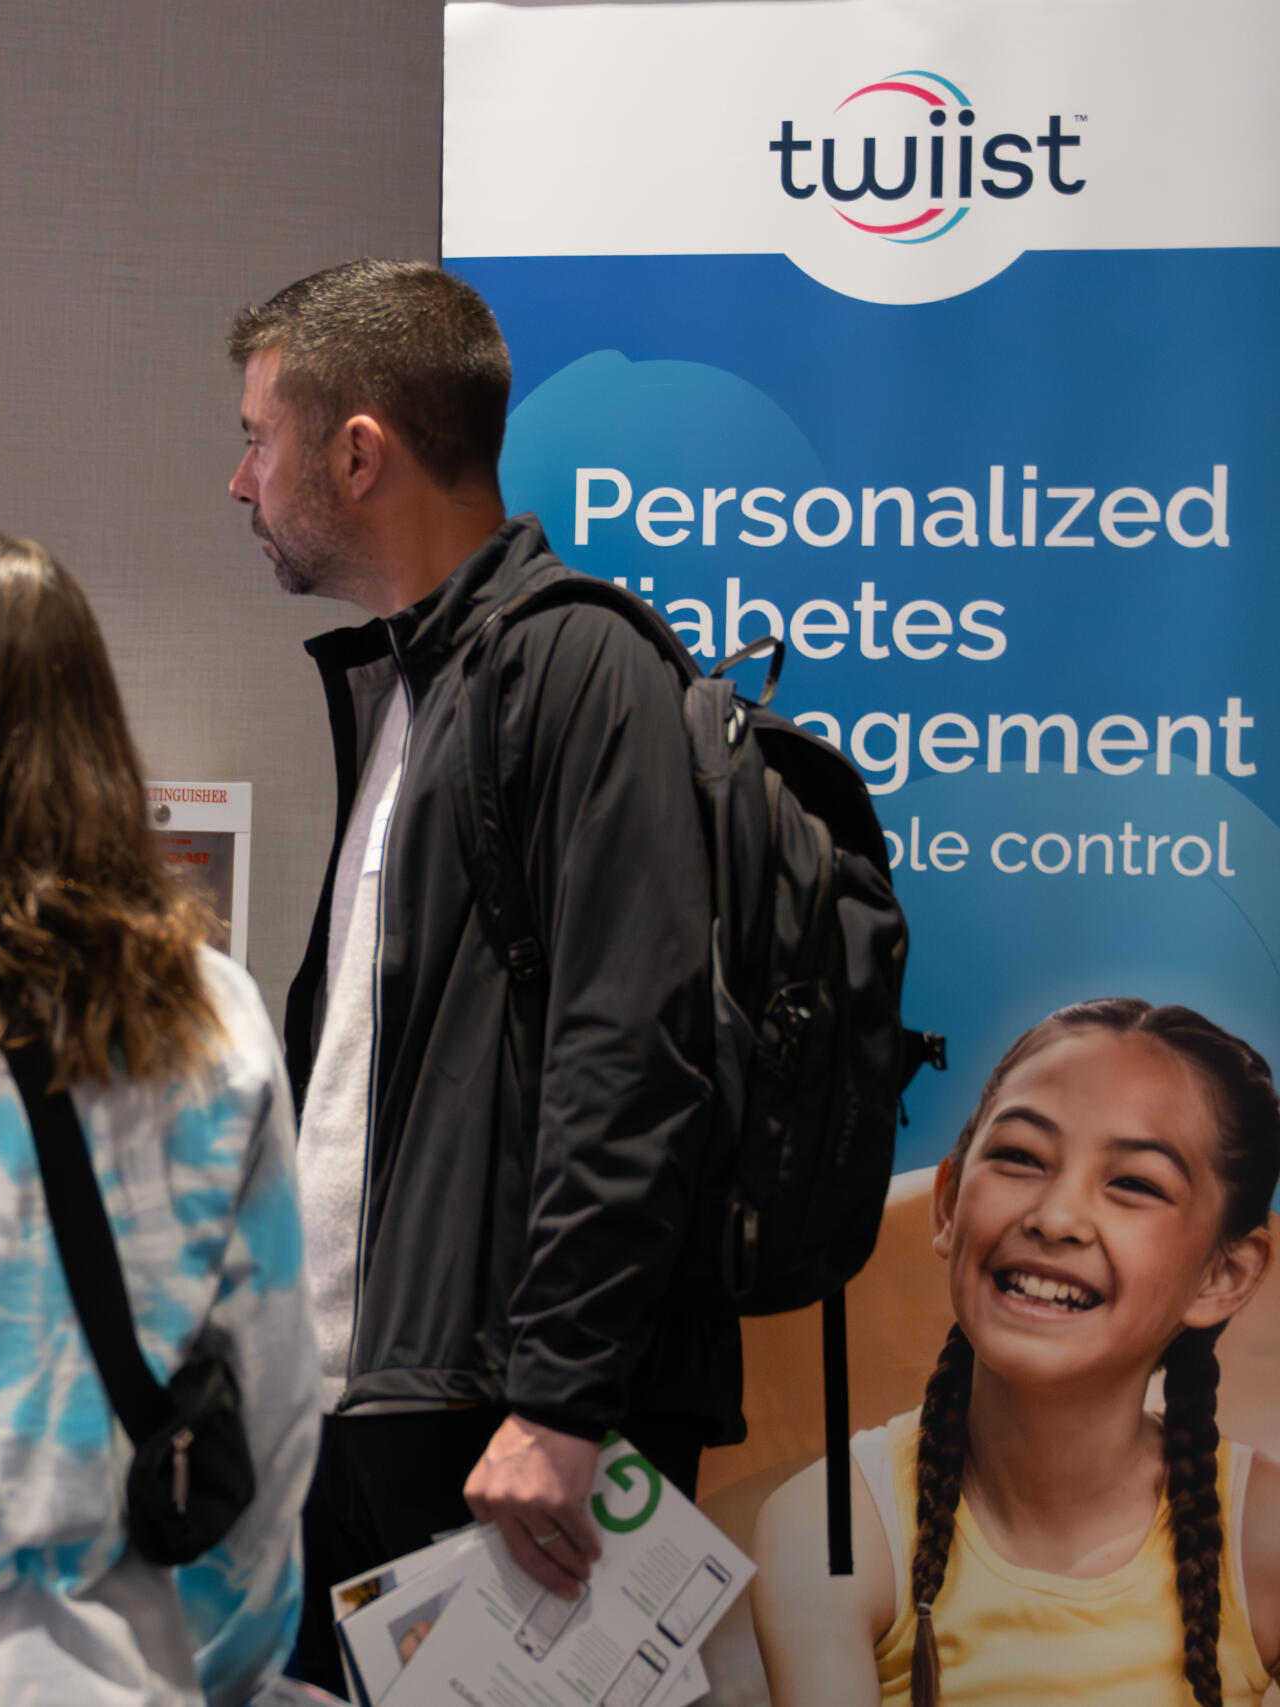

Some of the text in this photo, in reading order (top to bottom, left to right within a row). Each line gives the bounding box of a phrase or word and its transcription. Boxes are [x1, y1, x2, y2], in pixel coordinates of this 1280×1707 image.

[769, 109, 1086, 202] twiist
[573, 464, 1231, 549] Personalized
[613, 576, 1008, 661] abetes
[148, 787, 228, 803] TINGUISHER
[990, 820, 1236, 878] control
